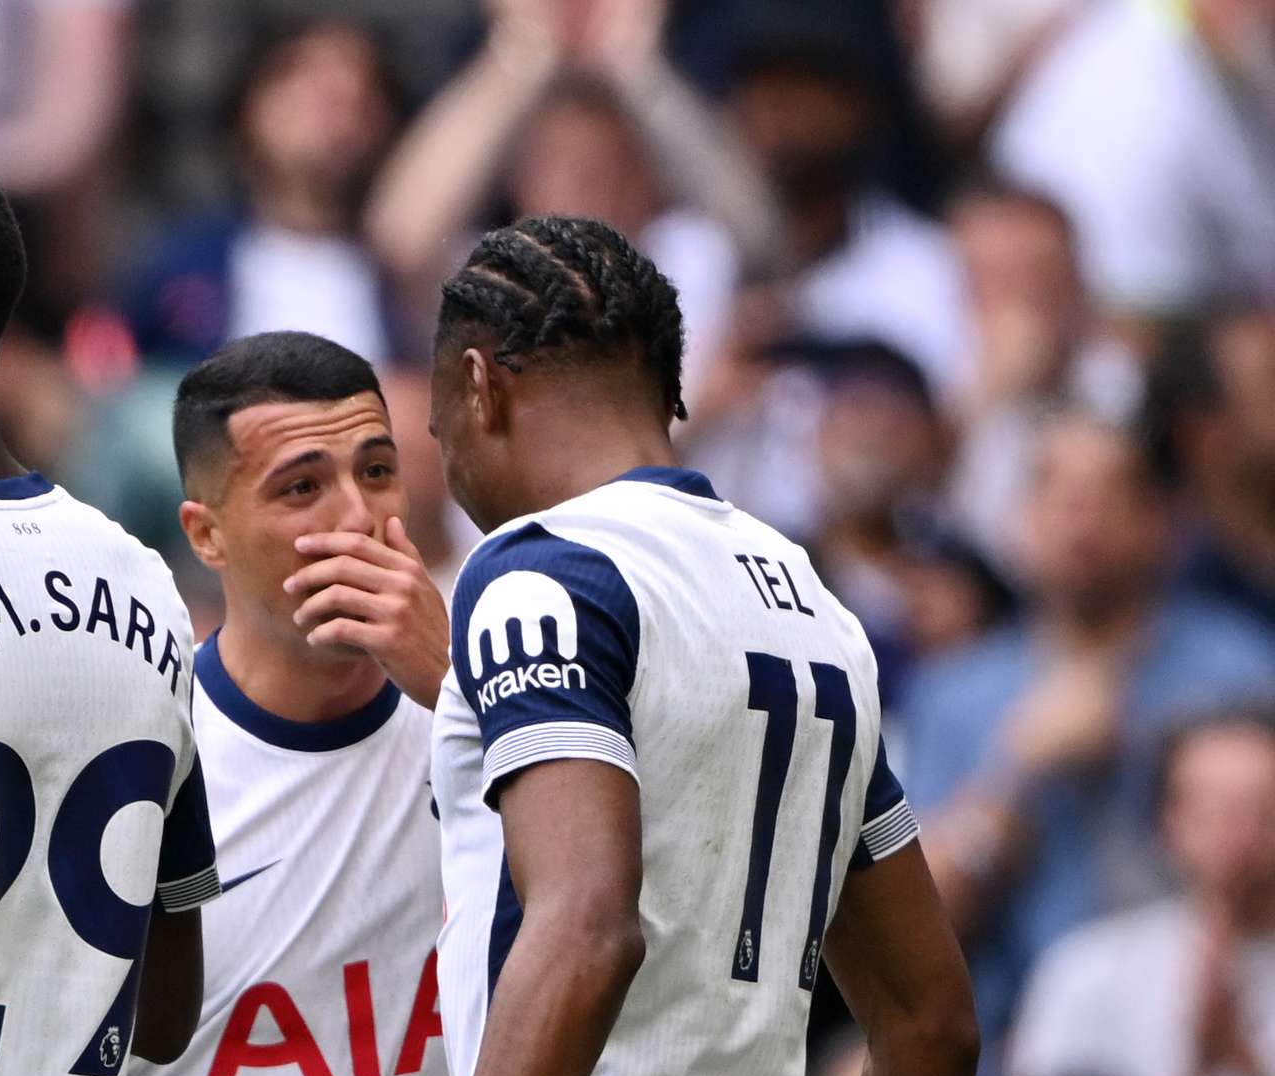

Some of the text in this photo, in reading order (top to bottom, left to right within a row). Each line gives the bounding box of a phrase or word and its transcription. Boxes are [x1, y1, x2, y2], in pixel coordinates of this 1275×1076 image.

[11, 522, 43, 536] 868
[734, 554, 816, 618] TEL
[477, 662, 587, 714] kraken
[731, 651, 857, 991] 11
